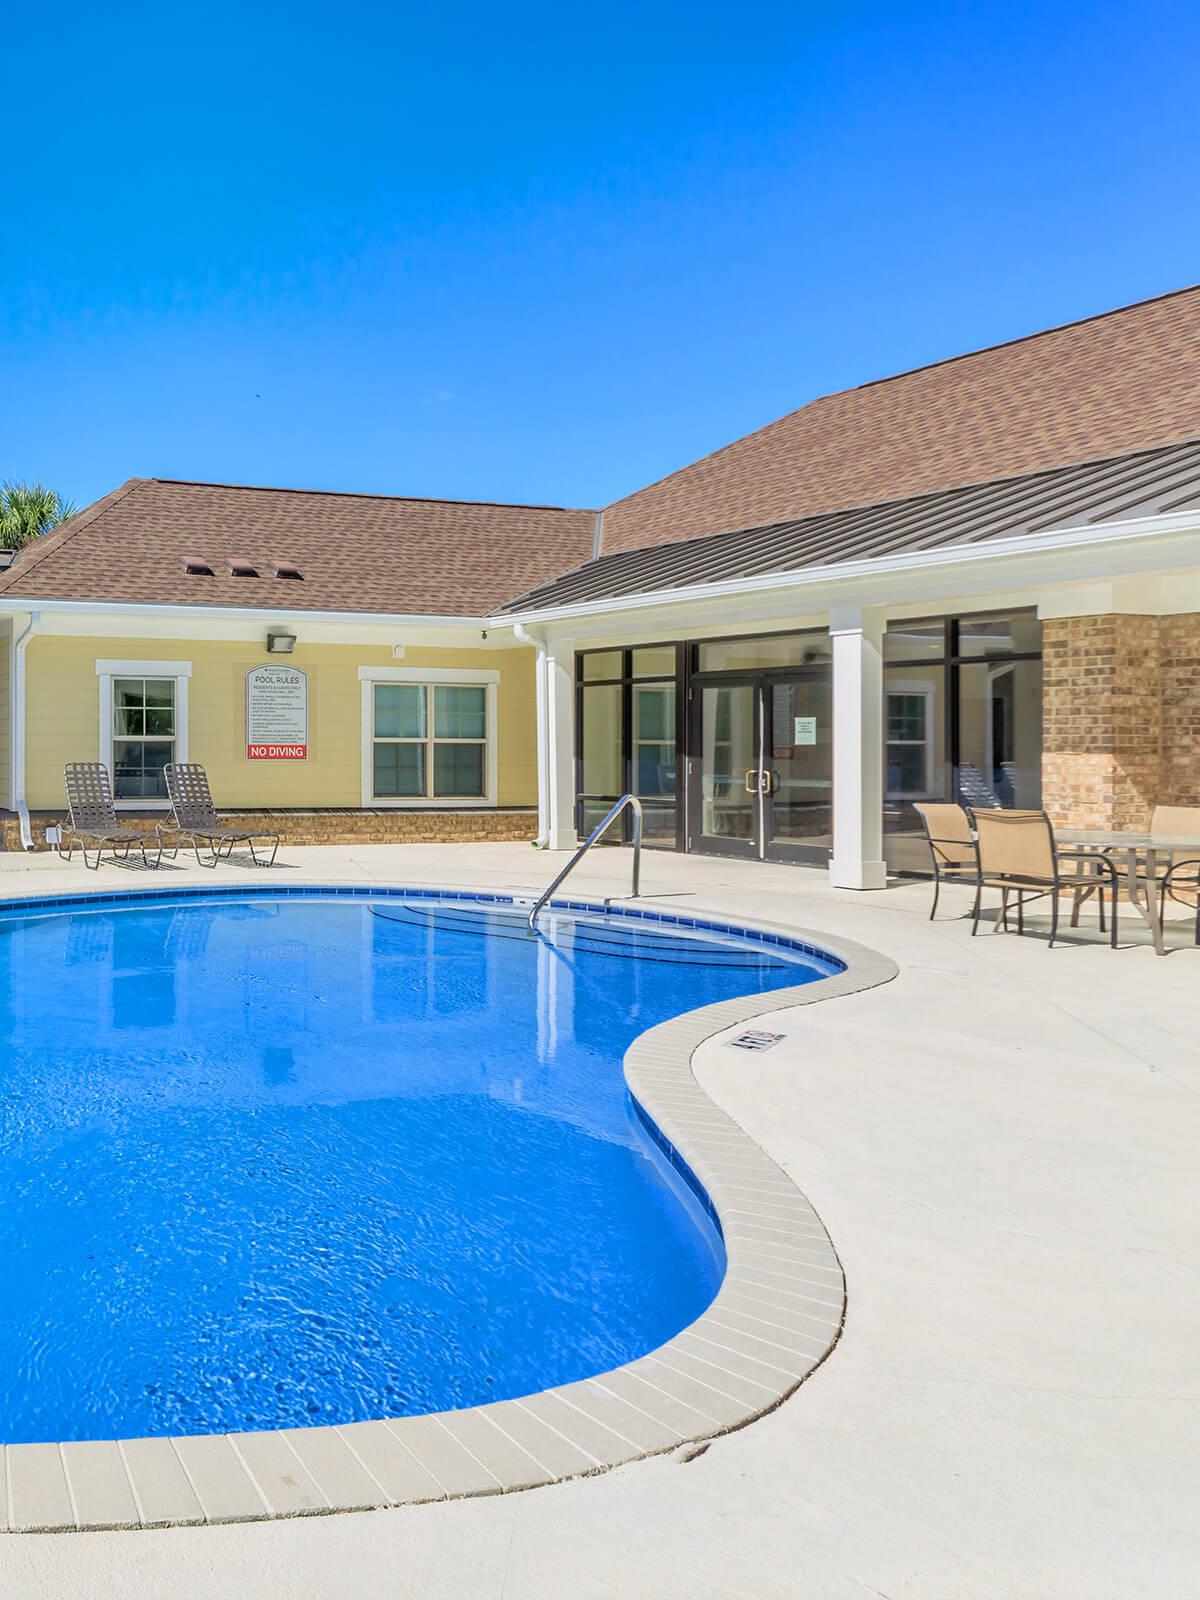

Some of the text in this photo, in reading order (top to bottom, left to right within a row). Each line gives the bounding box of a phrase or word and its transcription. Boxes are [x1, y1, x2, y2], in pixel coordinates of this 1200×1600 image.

[255, 676, 300, 684] POOL RULES
[251, 747, 303, 757] NO DIVING
